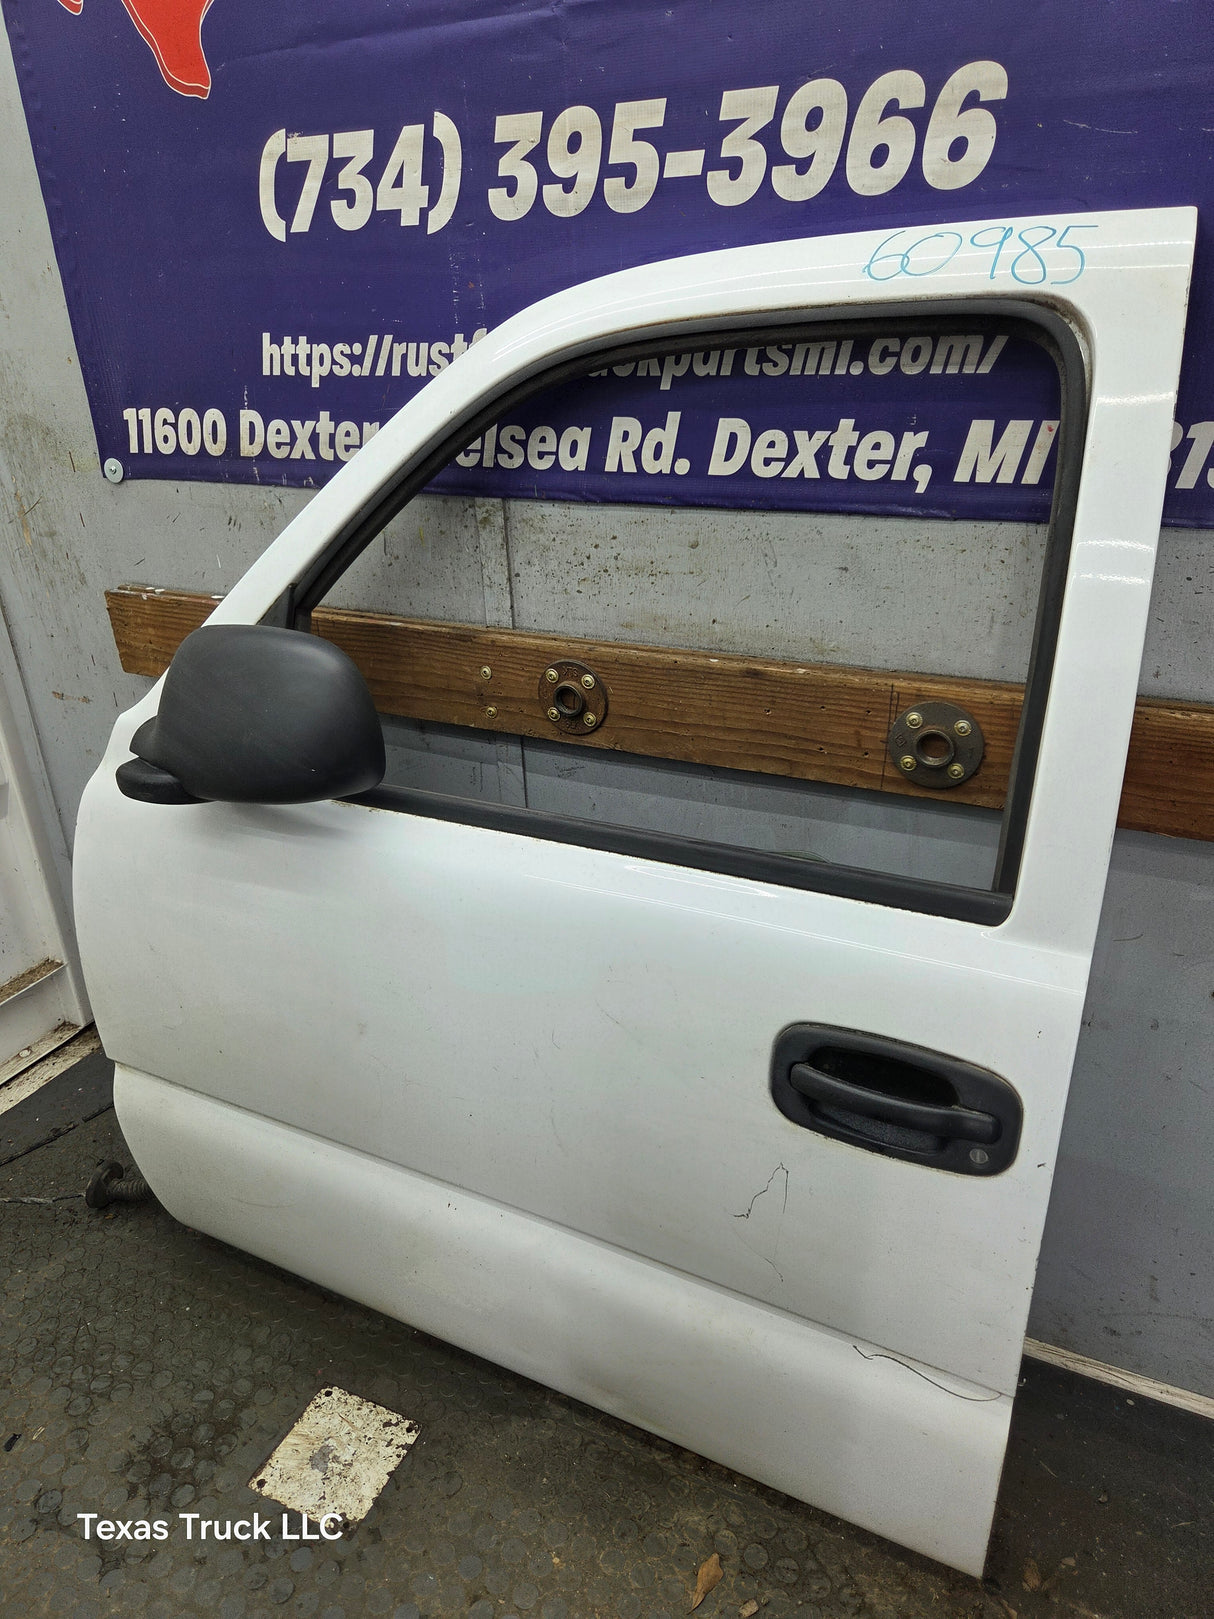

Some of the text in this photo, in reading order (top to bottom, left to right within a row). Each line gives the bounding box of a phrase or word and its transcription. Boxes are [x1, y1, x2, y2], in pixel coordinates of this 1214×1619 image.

[259, 60, 1009, 242] (734) 395-3966
[862, 225, 1099, 285] 60985
[123, 407, 227, 455] 11600
[455, 423, 592, 471] elsea
[604, 411, 691, 476] Rd.
[707, 417, 930, 493] Dexter,
[953, 420, 1060, 484] MI
